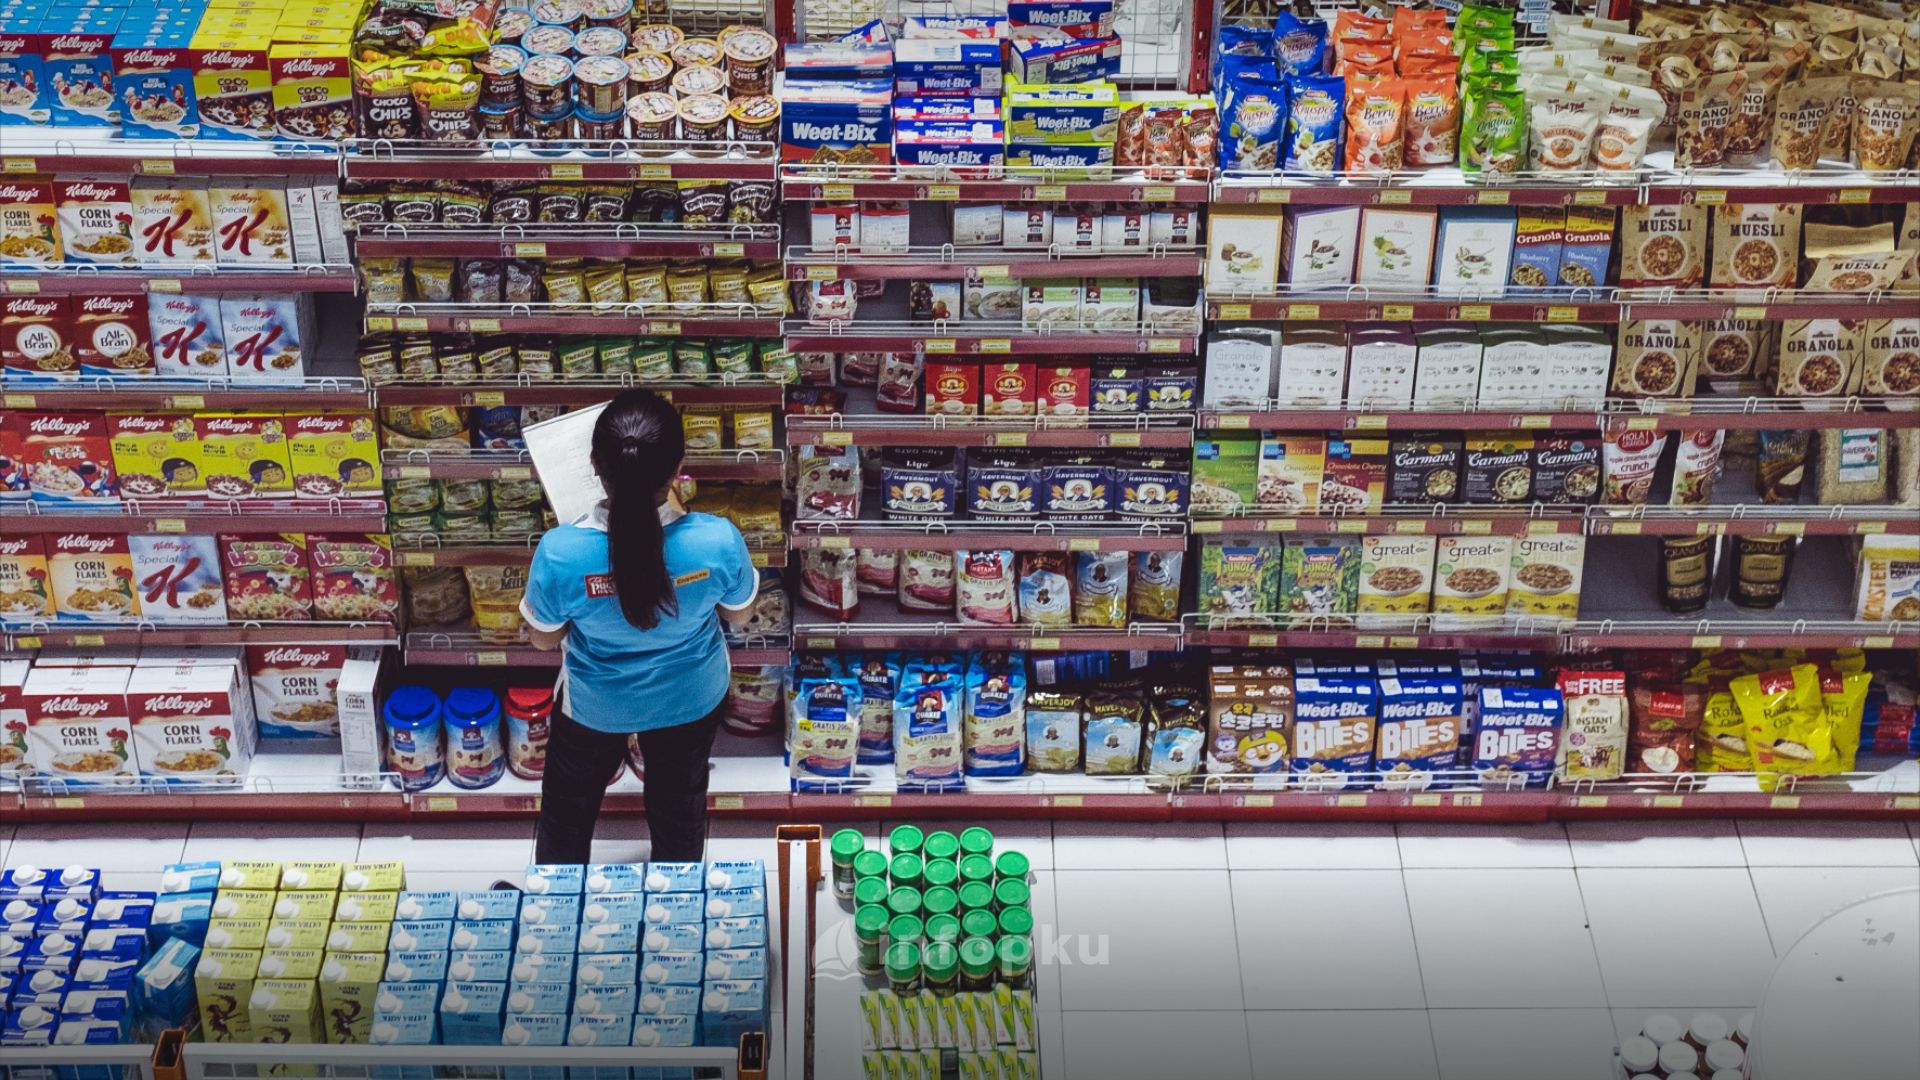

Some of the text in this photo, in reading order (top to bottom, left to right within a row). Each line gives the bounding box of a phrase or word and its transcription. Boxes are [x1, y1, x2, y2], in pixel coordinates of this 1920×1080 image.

[1029, 10, 1092, 24] Weet-Bix
[925, 19, 988, 29] Weet-Bix
[51, 35, 103, 51] Kellogg's
[124, 50, 176, 66] Kellogg's
[202, 51, 255, 68] Kellogg's
[282, 59, 336, 75] Kellogg's
[923, 77, 972, 88] Weet-Bix
[372, 97, 408, 107] CHOCO
[369, 108, 412, 122] CHIPS
[431, 111, 466, 119] CHOCO
[923, 106, 972, 115] Weet-Bix
[1364, 108, 1396, 120] Berry
[1415, 104, 1448, 118] Berry
[428, 120, 471, 132] CHIPS
[1037, 117, 1093, 129] Weet-Bix
[1701, 118, 1728, 128] BITES
[1870, 119, 1899, 129] BITES
[792, 122, 878, 142] Weet-Bix
[917, 151, 983, 165] Weet-Bix
[1033, 154, 1088, 166] Weet-Bix
[65, 184, 117, 200] Kellogg's
[4, 210, 30, 219] CORN
[79, 208, 111, 219] CORN
[138, 205, 173, 216] Special
[215, 205, 250, 216] Special
[81, 220, 113, 228] FLAKES
[1638, 219, 1692, 232] MUESLI
[143, 209, 193, 257] K
[220, 208, 270, 256] K
[1730, 224, 1785, 237] MUESLI
[1517, 231, 1561, 244] Granola
[1564, 232, 1610, 243] Granola
[1833, 262, 1888, 271] MUESLI
[7, 300, 58, 314] Kellogg's
[83, 298, 134, 312] Kellogg's
[156, 316, 190, 327] Special
[230, 323, 265, 333] Special
[30, 334, 48, 343] All-
[107, 330, 125, 340] All-
[24, 340, 53, 350] Bran
[100, 337, 129, 347] Bran
[160, 321, 207, 367] K
[1624, 335, 1691, 349] GRANOLA
[1787, 340, 1854, 352] GRANOLA
[1871, 336, 1920, 349] GRANO
[234, 325, 284, 372] K
[30, 416, 91, 435] Kellogg's
[119, 416, 165, 430] Kellogg's
[207, 420, 254, 432] Kellogg's
[297, 418, 344, 431] Kellogg's
[994, 459, 1016, 467] Ligo
[1395, 451, 1456, 466] Carman's
[1468, 451, 1529, 466] Carman's
[1537, 449, 1598, 466] Carman's
[906, 460, 929, 468] Ligo
[1361, 463, 1387, 471] Cherry
[1620, 461, 1649, 472] crunch
[894, 475, 938, 483] HAVERMOUT
[981, 474, 1026, 482] HAVERMOUT
[57, 534, 116, 552] Kellogg's
[1520, 540, 1565, 556] great
[1372, 543, 1416, 560] great
[1449, 544, 1492, 560] great
[74, 561, 106, 570] CORN
[137, 555, 180, 566] Special
[76, 571, 108, 579] FLAKES
[141, 556, 202, 609] K
[264, 648, 330, 666] Kellogg's
[282, 678, 317, 688] CORN
[1579, 678, 1625, 694] FREE
[283, 686, 319, 696] FLAKES
[41, 697, 108, 716] Kellogg's
[145, 696, 213, 715] Kellogg's
[1297, 702, 1369, 717] Weet-Bix
[1383, 702, 1455, 717] Weet-Bix
[812, 722, 836, 730] GRATIS
[1482, 714, 1555, 726] Weet-Bix
[1576, 716, 1613, 726] INSTANT
[60, 727, 98, 738] CORN
[164, 725, 200, 737] CORN
[1584, 725, 1608, 734] OATS
[63, 735, 100, 746] FLAKES
[165, 734, 203, 744] FLAKES
